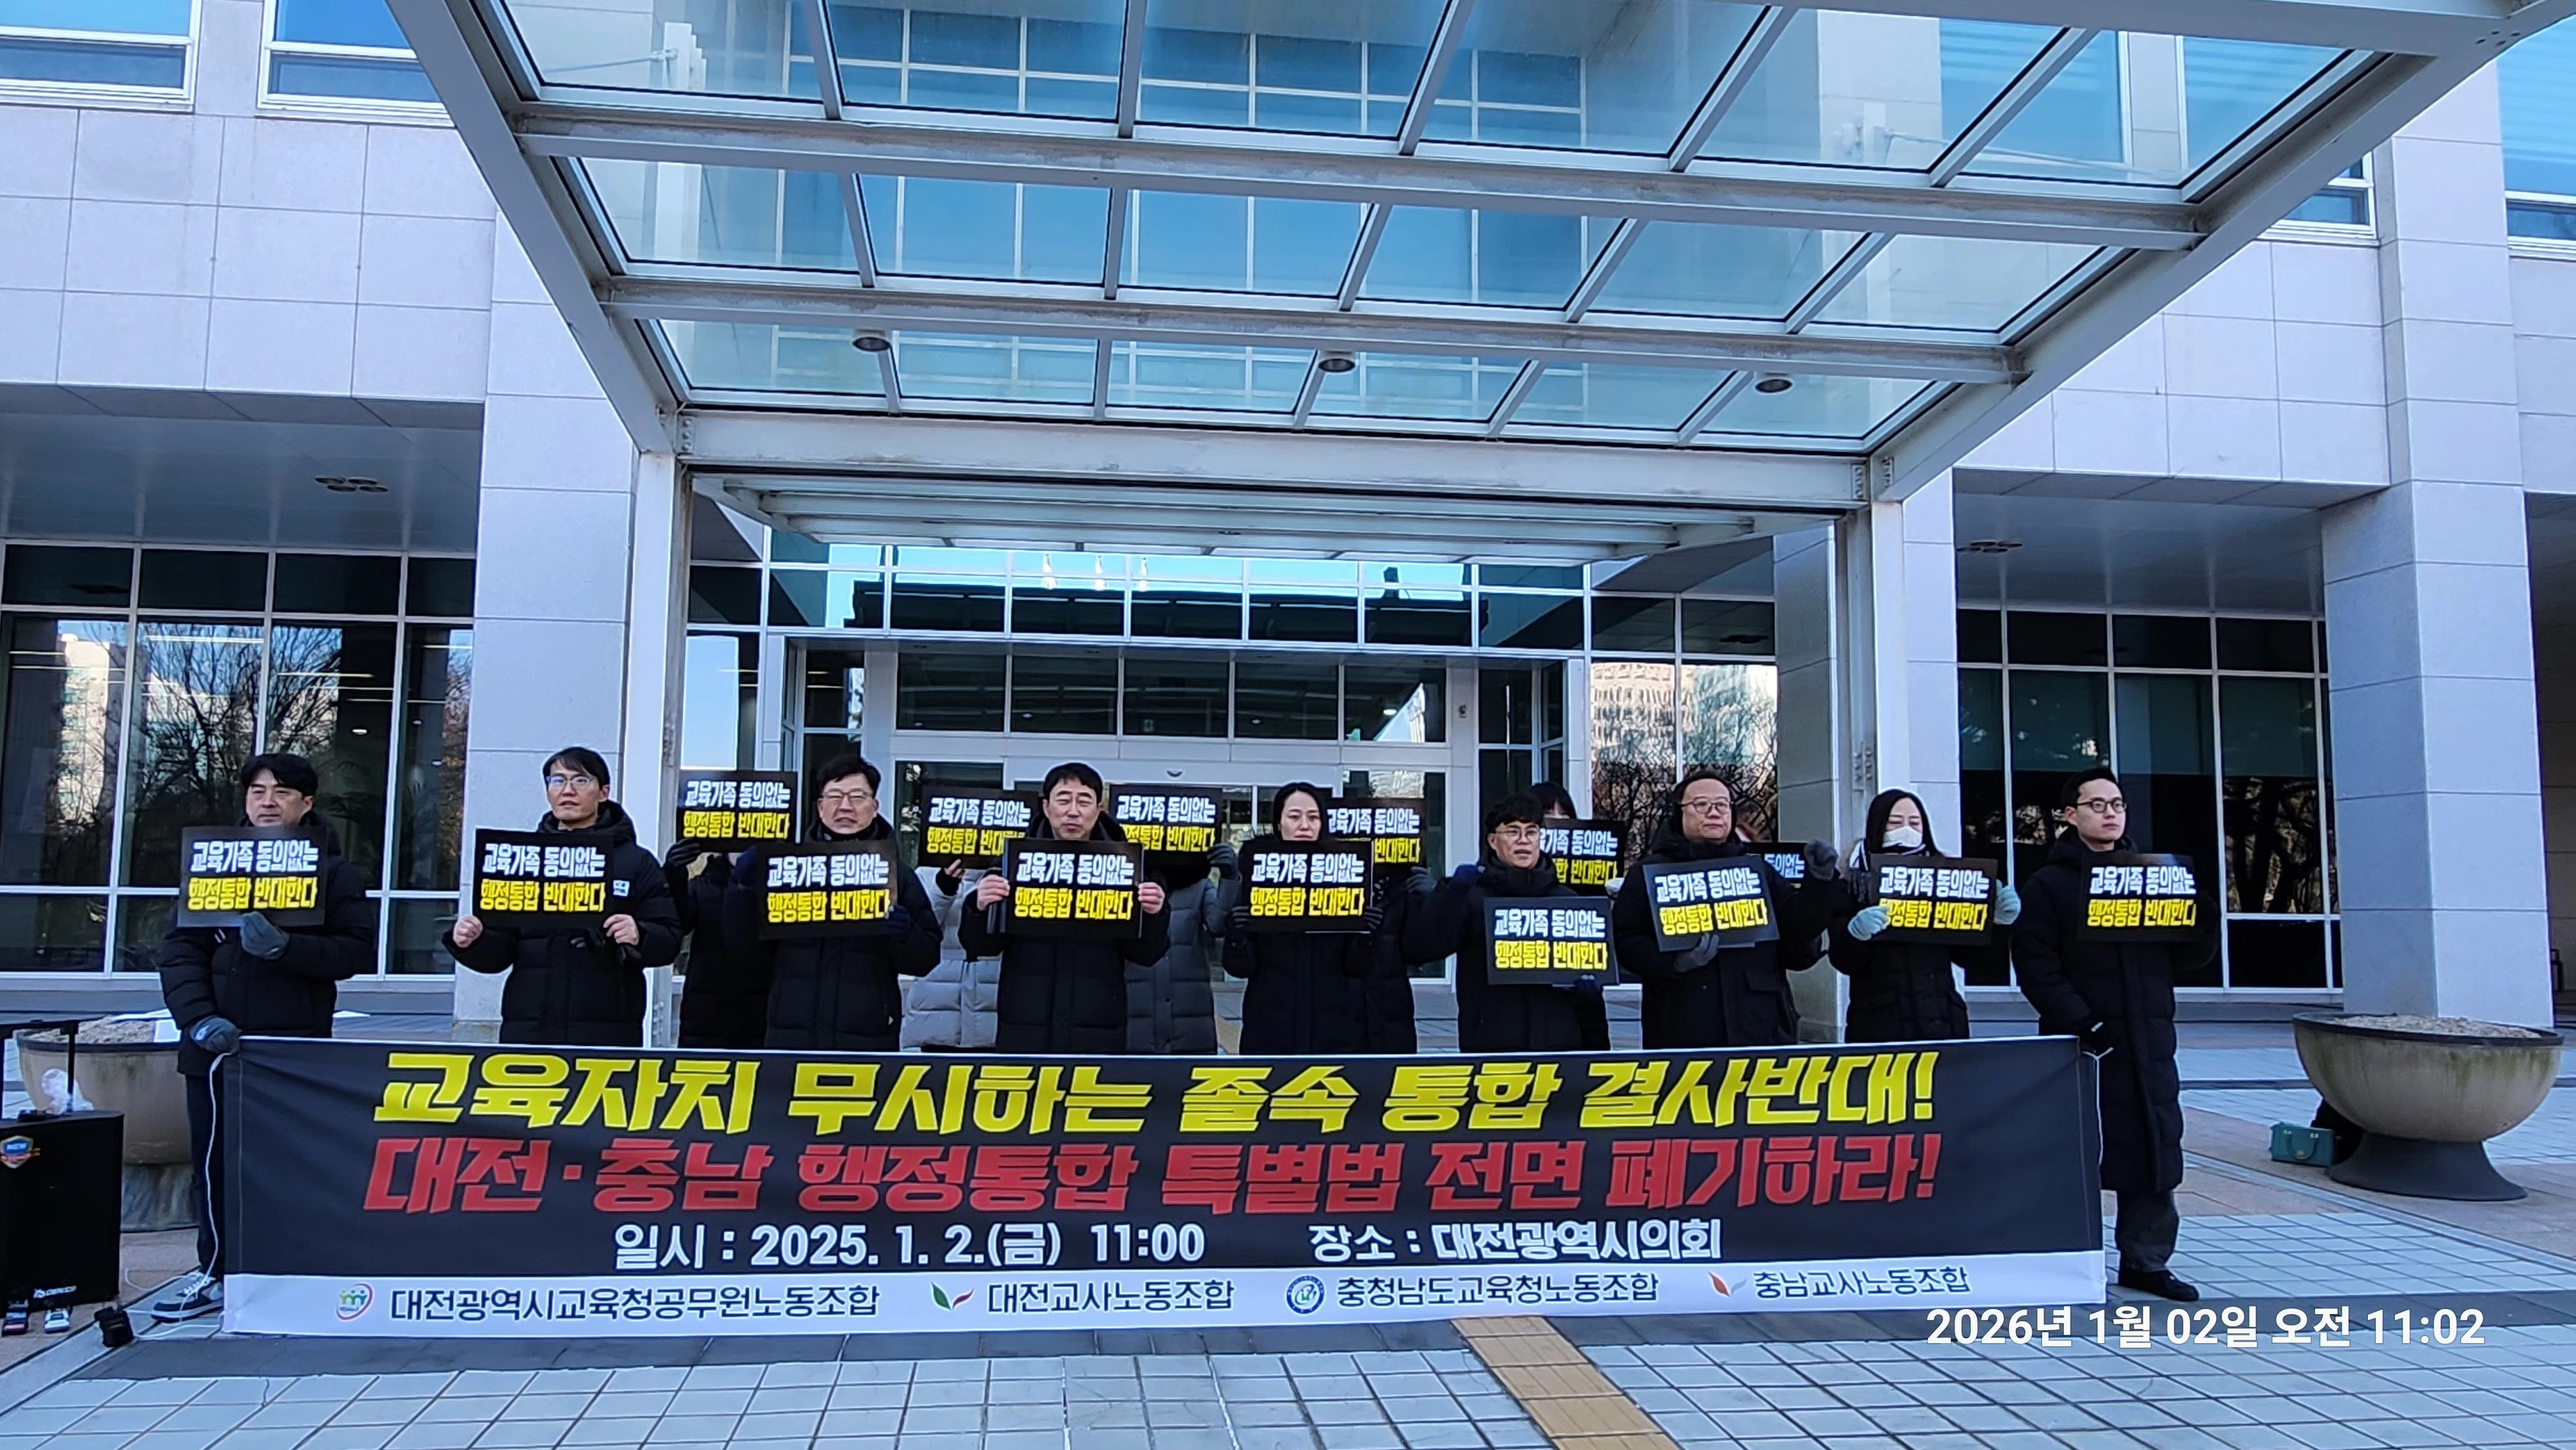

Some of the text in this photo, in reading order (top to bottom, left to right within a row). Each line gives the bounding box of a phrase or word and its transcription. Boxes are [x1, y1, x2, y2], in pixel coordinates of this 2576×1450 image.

[685, 780, 790, 808] 교육가족 동의없는
[1116, 795, 1216, 824] 교육가족 동의없는
[683, 811, 790, 839] 행정통합 반대한다
[929, 797, 1031, 827] 교육가족 동의없는
[1374, 808, 1420, 834] 동의없는
[927, 826, 1025, 856] 행정통합 반대
[1119, 824, 1215, 852] 정통합 반대한다
[1374, 838, 1421, 863] 반대한다
[1571, 829, 1618, 856] 동의없는
[191, 840, 319, 872] 교육가족 동의없는
[482, 843, 605, 877] 교육가족 동의없는
[768, 854, 889, 887] 교육가족 동의없는
[1017, 852, 1134, 885] 교육가족 동의없는
[1251, 853, 1365, 883] 교육가족 동의없는
[188, 876, 317, 909] 행정통합 반대한다
[480, 878, 540, 911] 행정통합
[544, 882, 605, 912] 반대한다
[1655, 867, 1761, 902] 교육가족 동의없는
[1879, 867, 1989, 898] 교육가족 동의없는
[2090, 866, 2196, 895] 교육가족 동의없는
[768, 889, 890, 923] 행정통합 반대한다
[1014, 887, 1133, 920] 행정통합 반대한다
[1251, 887, 1365, 916] 행정통합 반대한다
[1660, 898, 1768, 935] 행정통합 반대한다
[1933, 901, 1988, 931] 반대한다
[2088, 899, 2142, 927] 행정통합
[1494, 909, 1605, 937] 교육가족 동의없는
[1495, 941, 1607, 970] 행정통합 반대한다
[373, 1051, 1939, 1135] 교육자치 무시하는 졸속 통합 결사반대!
[797, 1144, 1139, 1212] 행정통합
[1162, 1142, 1406, 1214] 특별법
[1425, 1140, 1586, 1210] 전면
[1606, 1133, 1942, 1209] 폐기하라!
[615, 1218, 1721, 1270] 일시 : 2025. 1. 2.(금) 11:00 장소 : 대전광역시의회
[988, 1281, 1234, 1313] 대전교사노동조합
[1337, 1274, 1659, 1307] 충청남도교육청노동조합
[1753, 1266, 1971, 1299] 충남교사노동조합
[390, 1285, 880, 1322] 대전광역시교육청공무원노동조합
